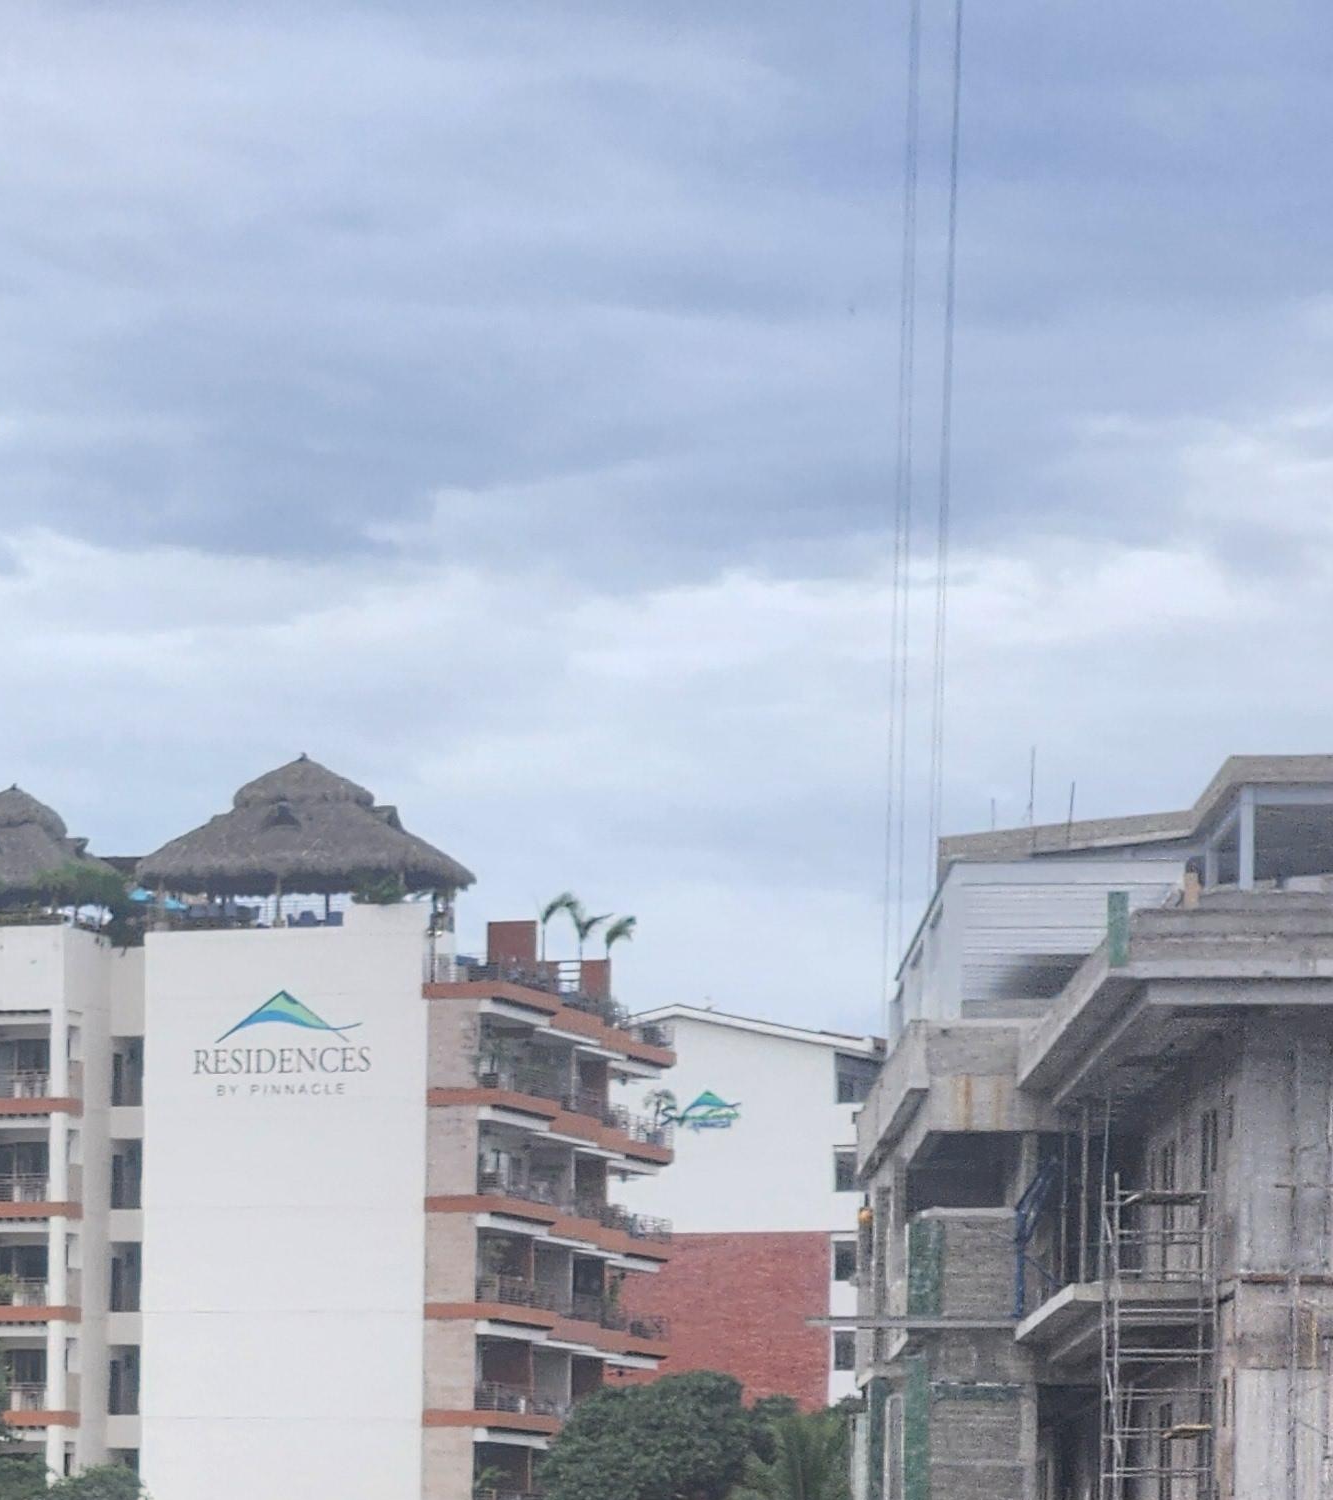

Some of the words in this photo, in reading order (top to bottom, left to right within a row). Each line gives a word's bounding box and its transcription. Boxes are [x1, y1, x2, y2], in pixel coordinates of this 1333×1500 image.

[193, 1046, 372, 1075] RESIDENCES
[216, 1084, 239, 1097] BY
[250, 1083, 346, 1096] PINNACLE
